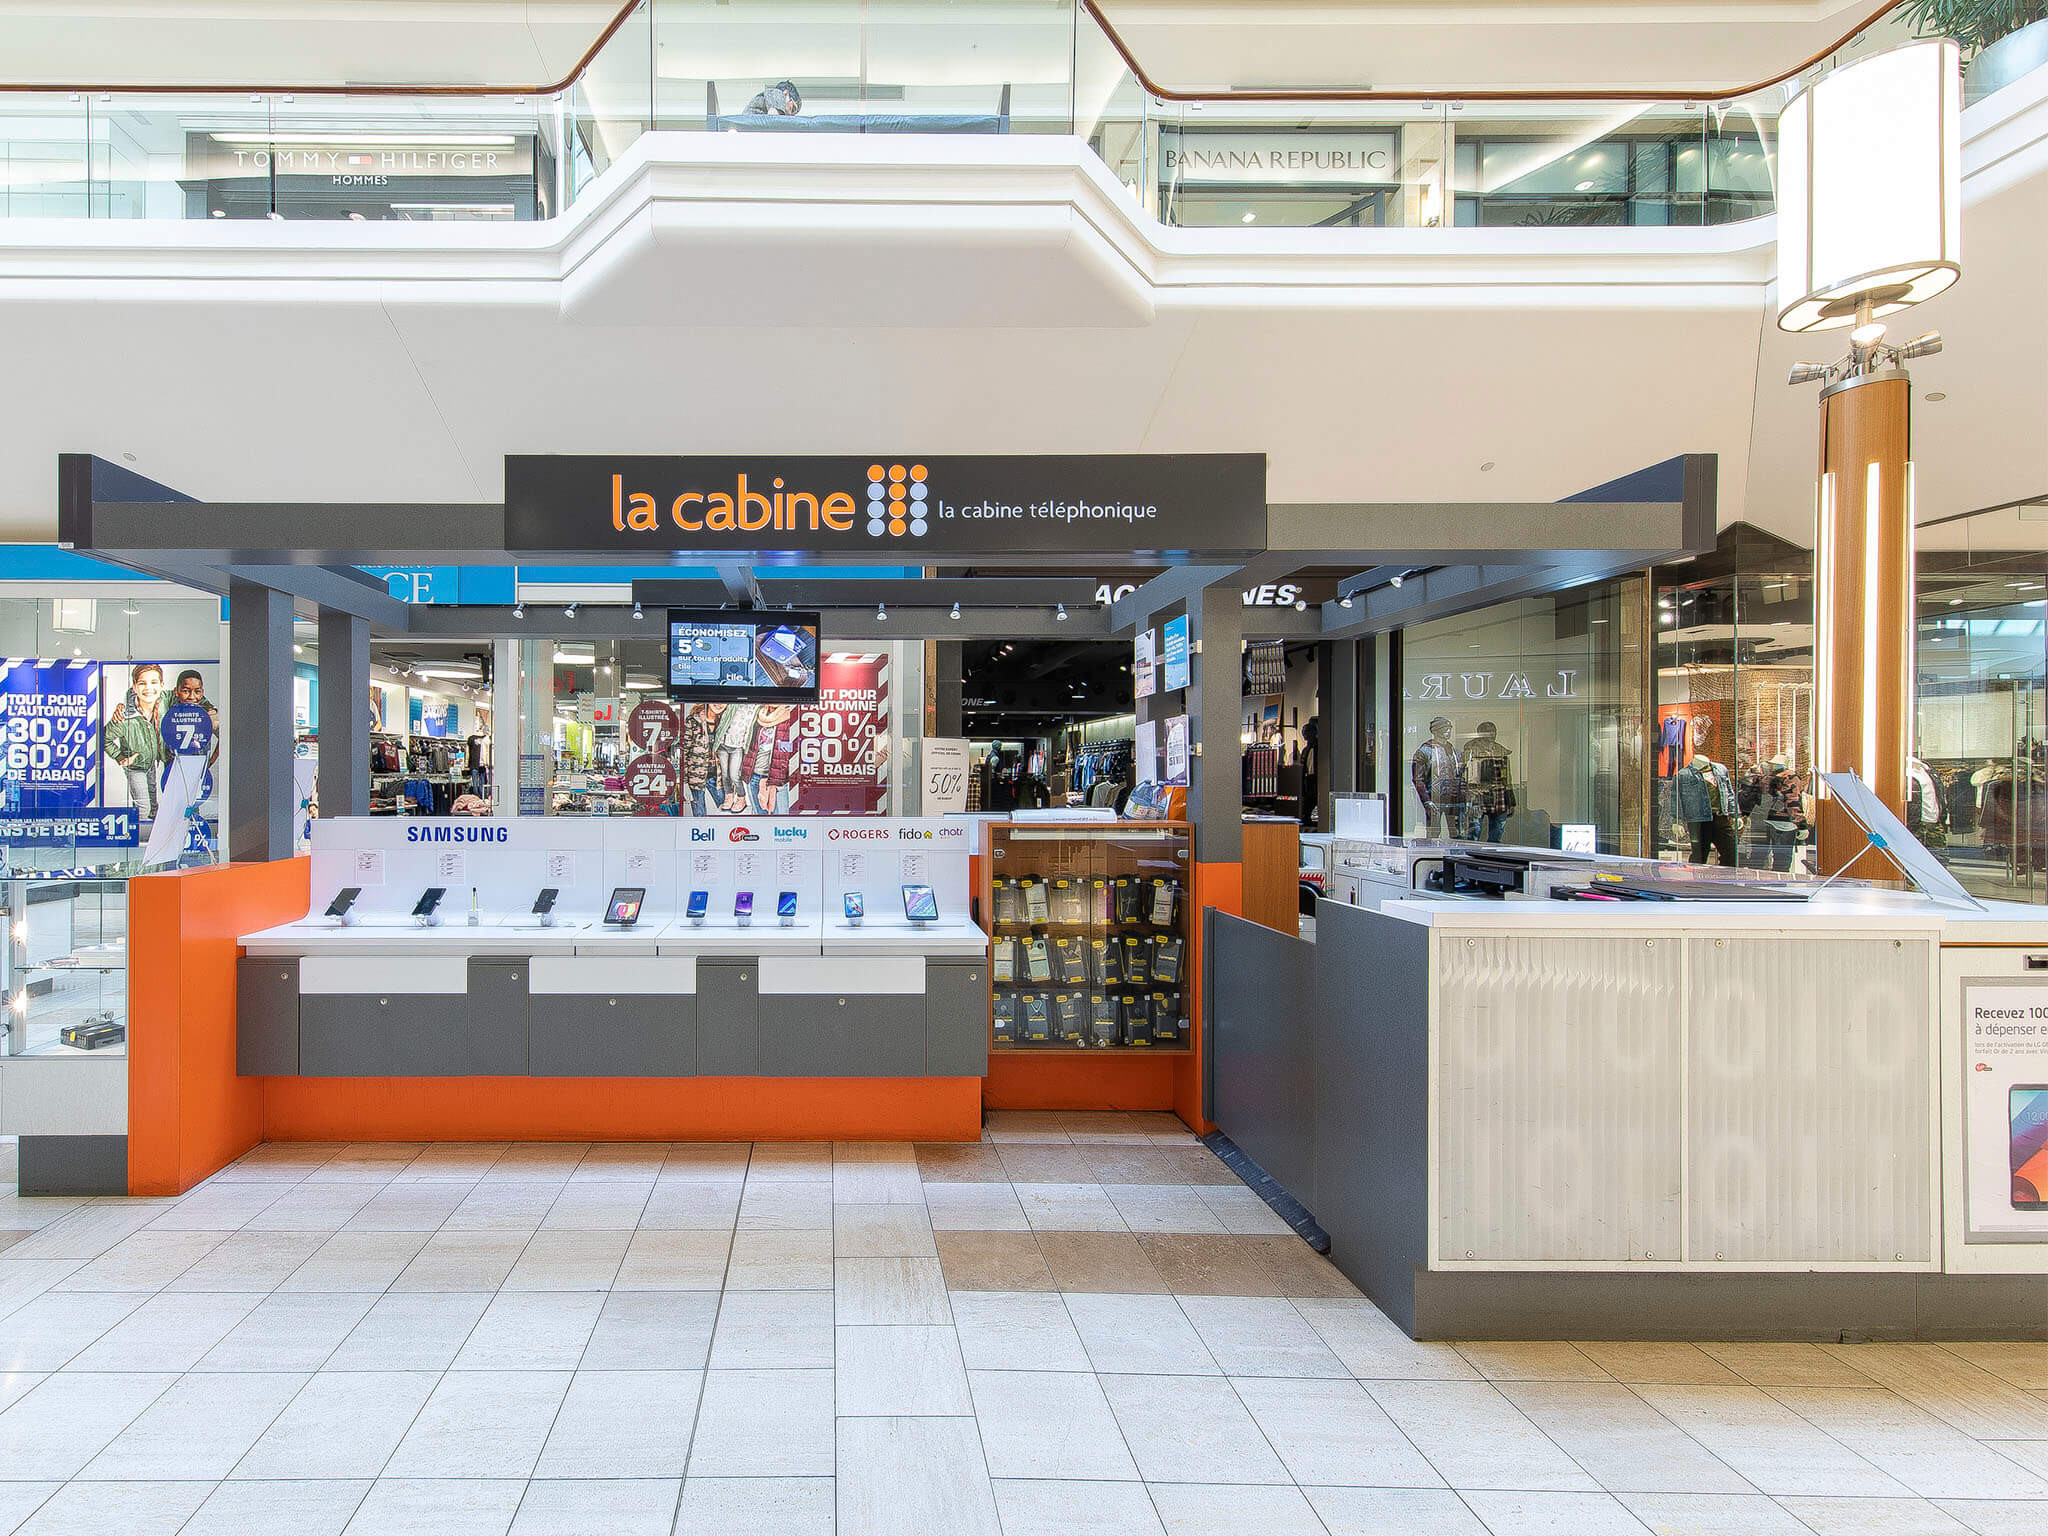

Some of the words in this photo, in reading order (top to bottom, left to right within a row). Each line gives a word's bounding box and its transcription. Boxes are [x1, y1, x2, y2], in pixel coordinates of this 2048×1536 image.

[234, 151, 340, 168] TOMMY
[381, 152, 498, 168] HILFIGER
[1166, 150, 1263, 169] BANANA
[1269, 150, 1386, 169] REPUBLIC
[332, 175, 388, 185] HOMMES
[612, 474, 659, 532] la
[671, 473, 857, 532] cabine
[939, 501, 955, 519] la
[961, 500, 1022, 520] cabine
[1030, 500, 1157, 523] téléphonique
[678, 627, 747, 638] ÉCONOMISEZ
[8, 694, 44, 705] TOUT
[48, 694, 87, 706] POUR
[820, 689, 836, 700] UT
[840, 689, 876, 700] POUR
[8, 705, 87, 717] L'AUTOMNE
[8, 717, 86, 744] 30%
[801, 712, 877, 738] 30%
[8, 743, 86, 769] 60%
[801, 738, 875, 764] 60%
[7, 769, 26, 780] DE
[32, 770, 85, 781] RABAIS
[800, 764, 819, 775] DE
[824, 764, 876, 775] RABAIS
[929, 773, 962, 794] 50%
[54, 823, 99, 836] BASE
[407, 826, 509, 842] SAMSUNG
[691, 828, 715, 841] Bell
[774, 826, 807, 839] lucky
[842, 829, 890, 840] ROGERS
[898, 828, 922, 840] fido
[938, 827, 963, 837] chatr
[1975, 1007, 2025, 1019] Recevez
[1975, 1023, 1982, 1035] à
[1985, 1023, 2037, 1038] dépenser
